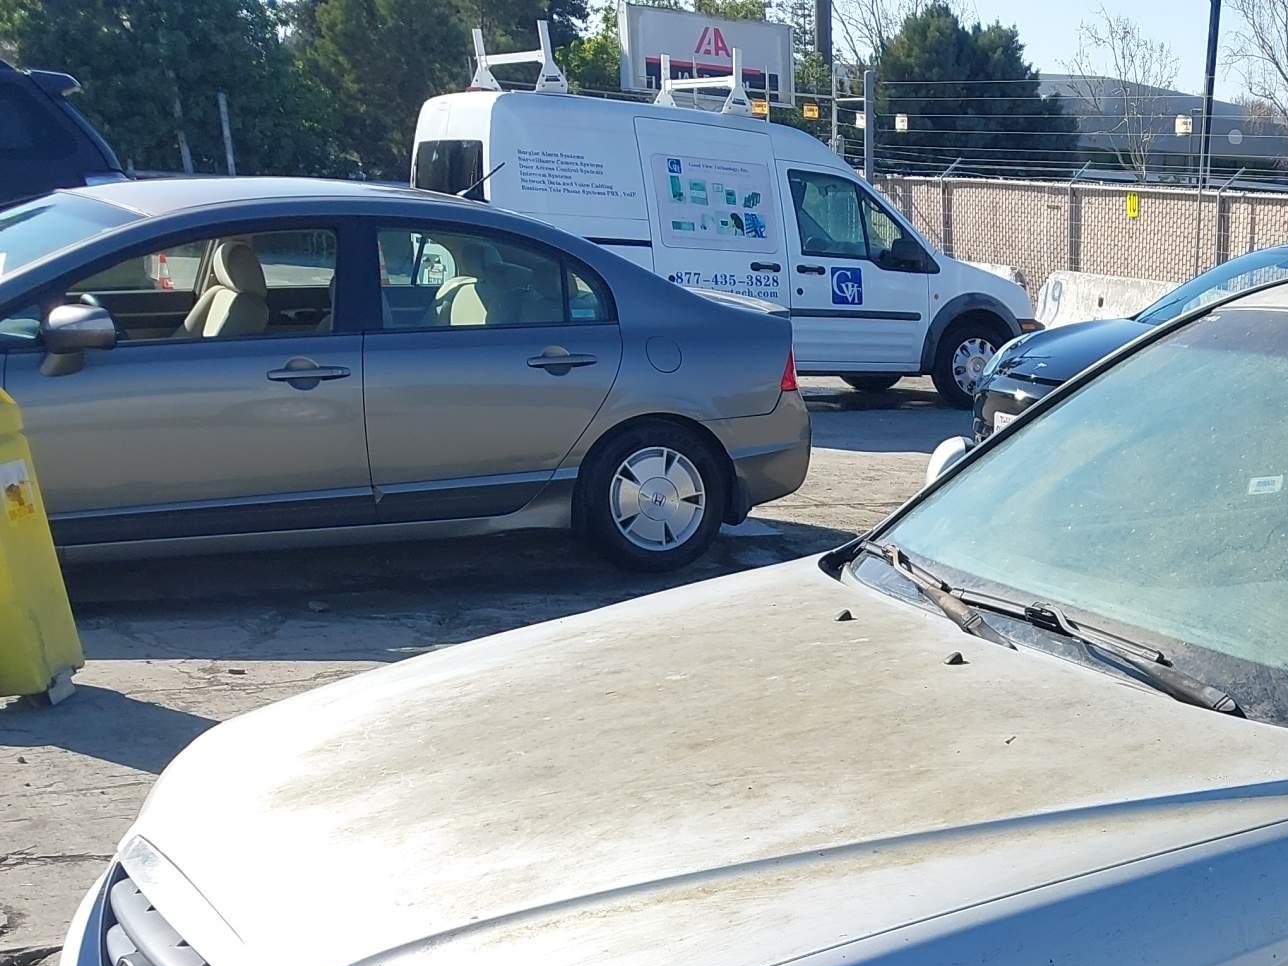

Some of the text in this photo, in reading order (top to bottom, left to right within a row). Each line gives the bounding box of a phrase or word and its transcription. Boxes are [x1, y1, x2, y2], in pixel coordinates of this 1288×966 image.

[518, 156, 555, 164] Surveillance
[519, 170, 547, 178] Intercom
[1129, 193, 1136, 213] 10
